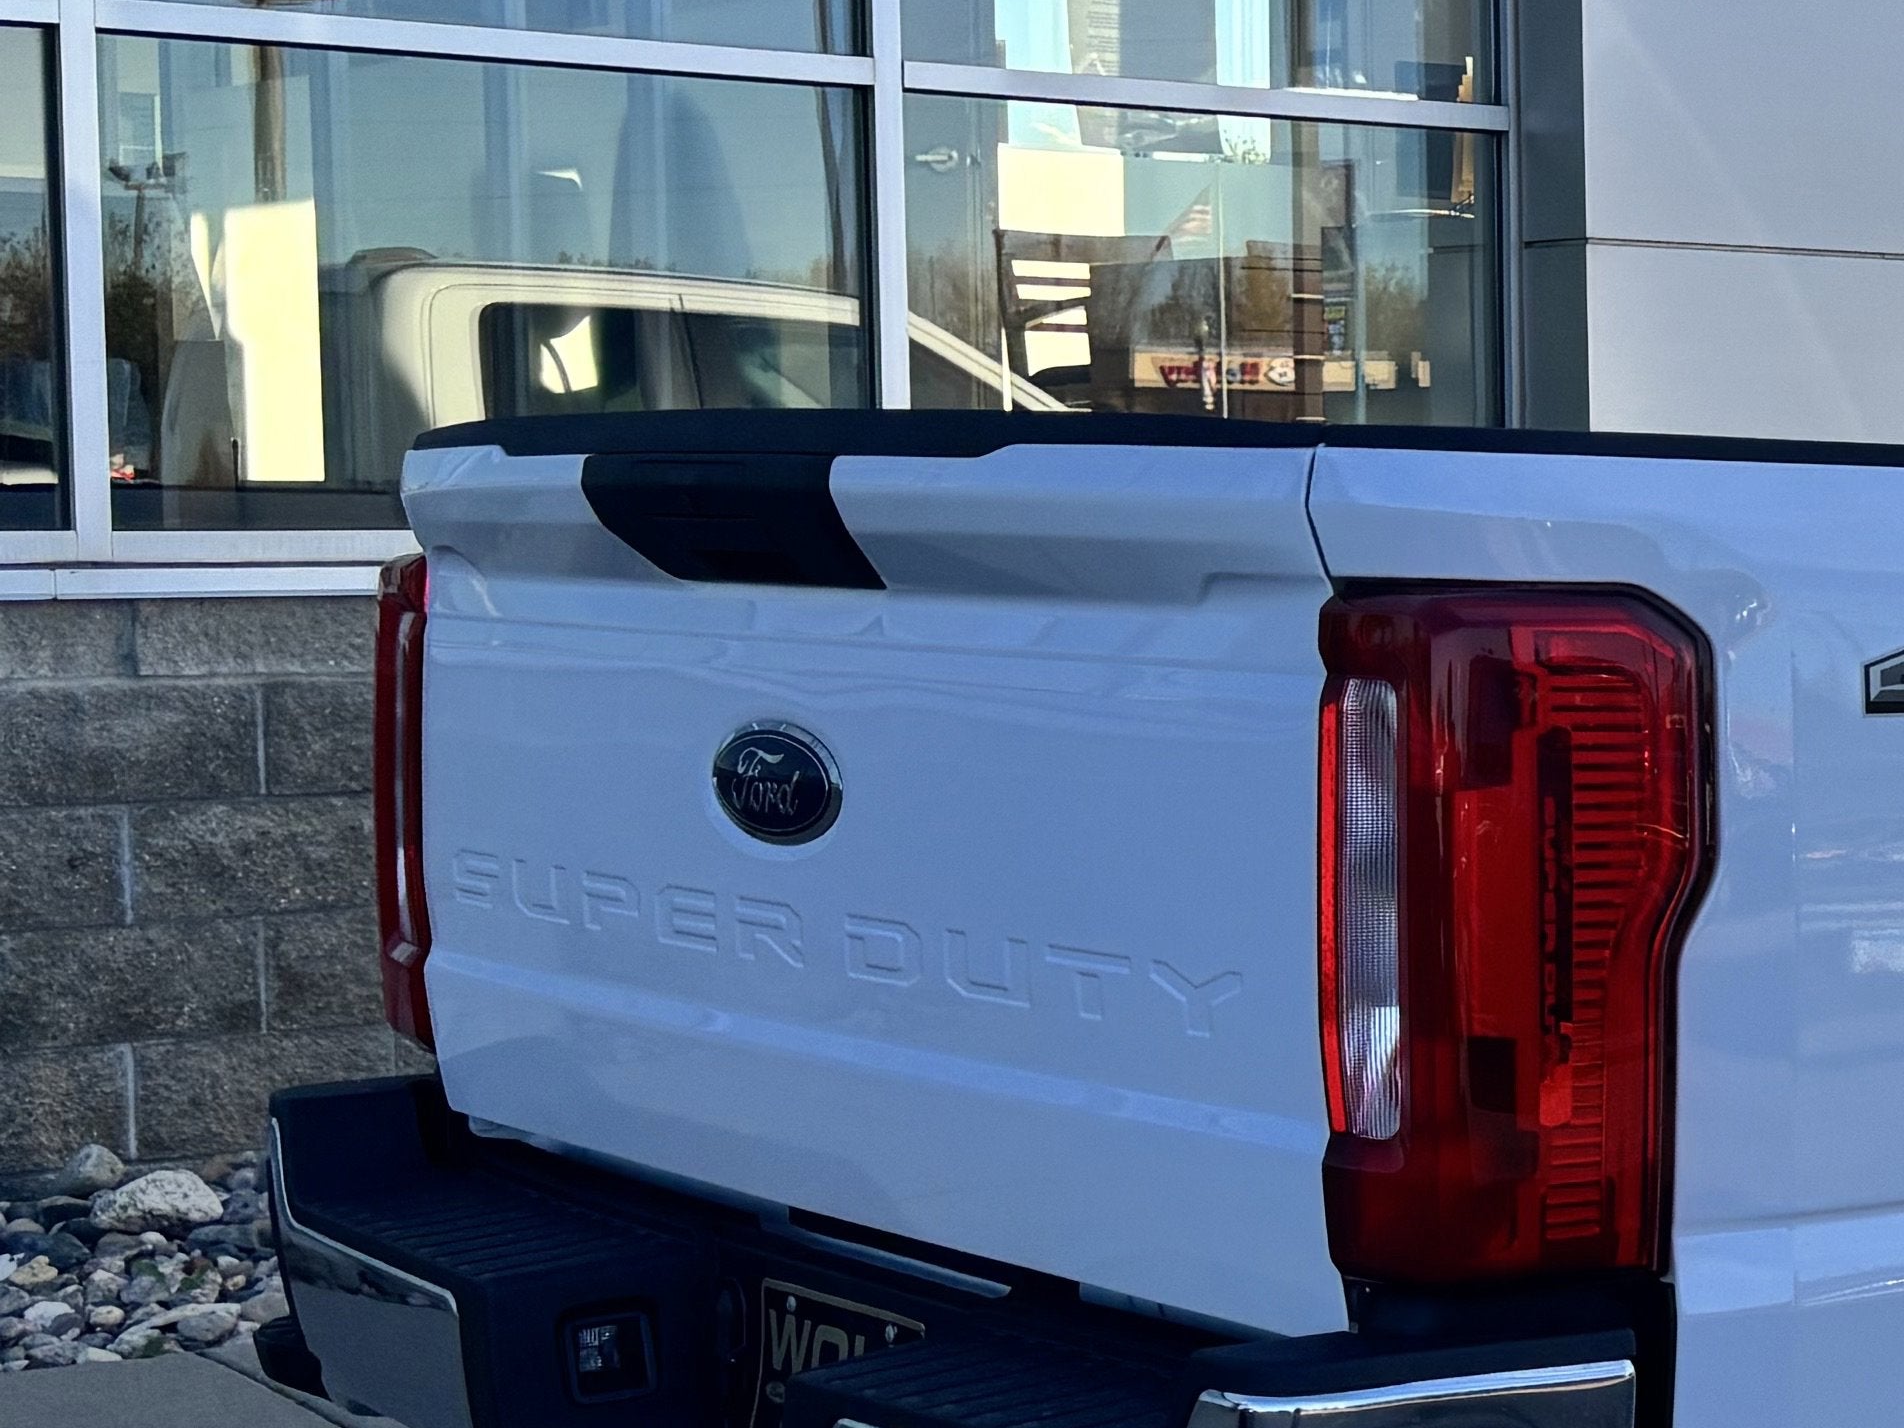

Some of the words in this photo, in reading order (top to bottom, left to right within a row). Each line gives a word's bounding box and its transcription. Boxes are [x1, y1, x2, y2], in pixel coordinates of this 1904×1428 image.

[730, 744, 801, 817] Ford
[452, 847, 806, 970] SUPER
[843, 912, 1245, 1040] DUTY
